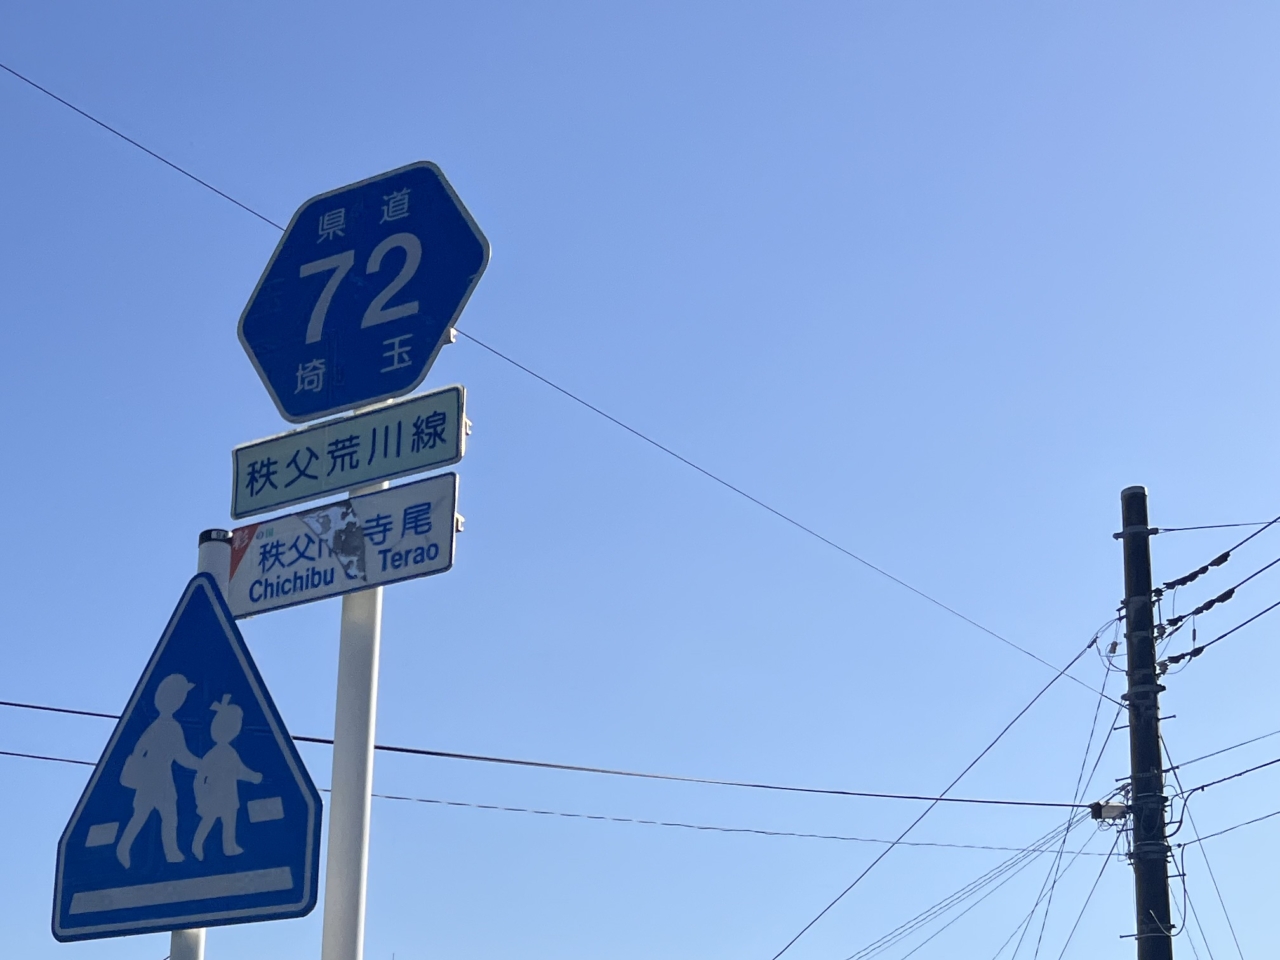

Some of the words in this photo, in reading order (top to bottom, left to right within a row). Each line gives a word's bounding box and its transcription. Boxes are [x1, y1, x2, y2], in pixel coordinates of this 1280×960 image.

[299, 232, 423, 345] 72
[294, 333, 413, 394] 埼玉
[245, 410, 447, 498] 秩父荒川線
[249, 566, 335, 603] Chichibu
[378, 542, 440, 572] Terao
